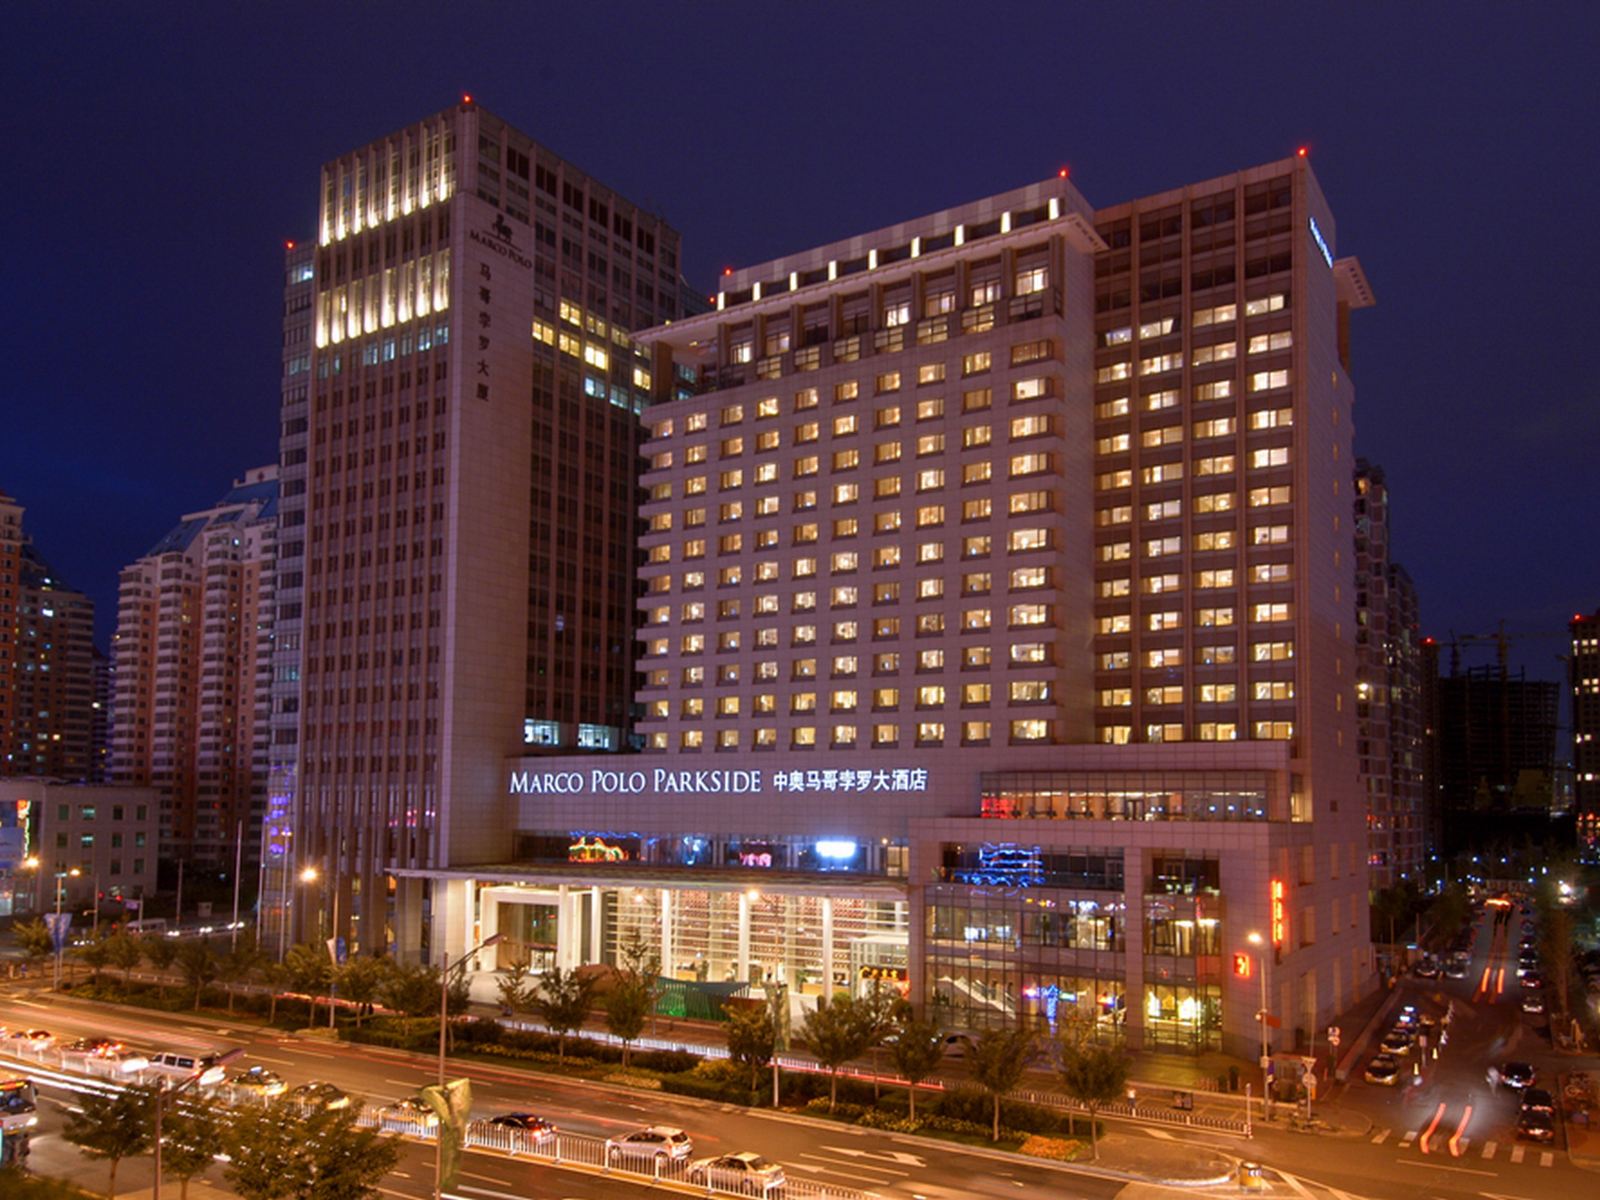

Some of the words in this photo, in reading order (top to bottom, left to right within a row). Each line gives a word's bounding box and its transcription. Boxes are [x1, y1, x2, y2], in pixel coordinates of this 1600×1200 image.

[469, 229, 508, 257] MARCO
[508, 248, 533, 270] POLO
[509, 771, 585, 794] MARCO
[591, 770, 647, 794] POLO
[653, 769, 762, 793] PARKSIDE
